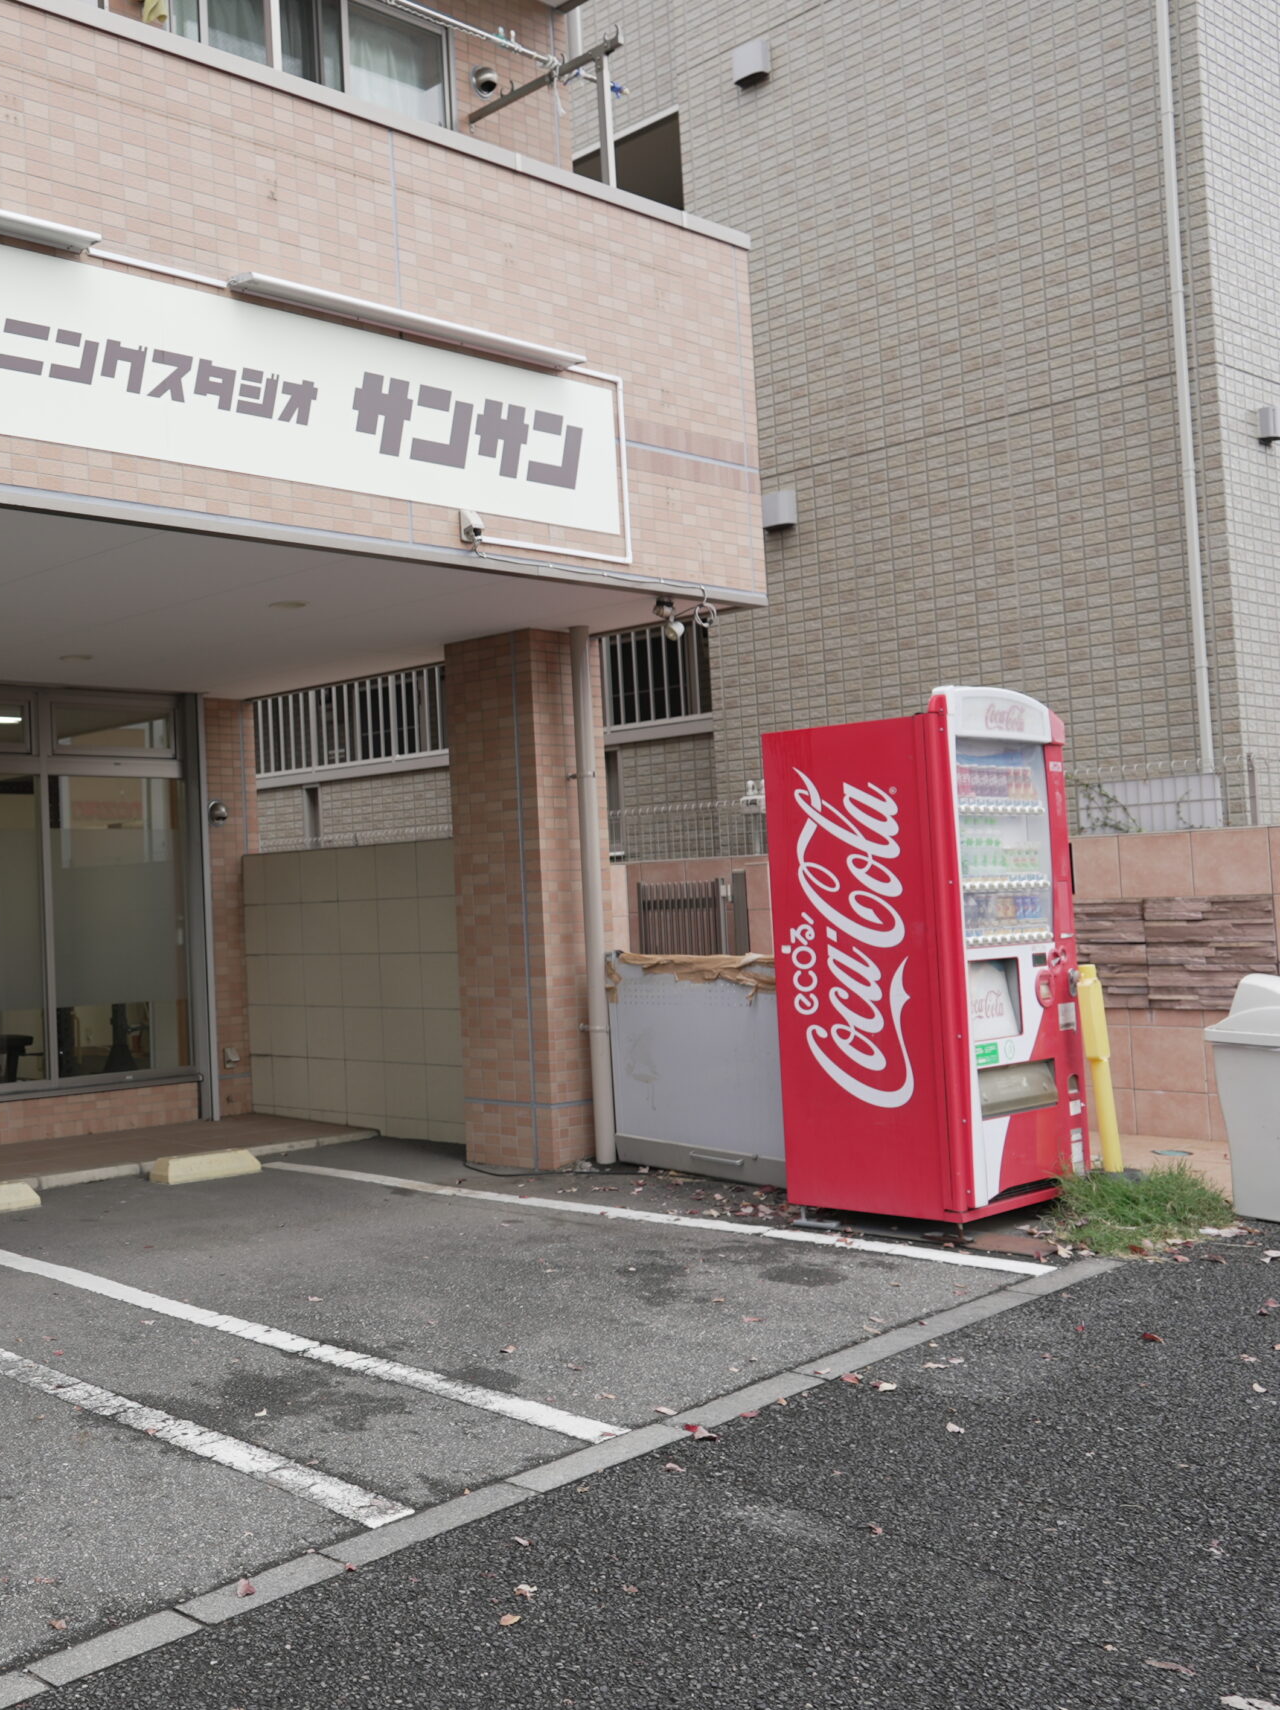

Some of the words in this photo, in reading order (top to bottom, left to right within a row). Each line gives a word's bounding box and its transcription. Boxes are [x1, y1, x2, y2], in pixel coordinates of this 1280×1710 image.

[352, 370, 584, 490] サンサン
[791, 766, 915, 1109] Coca-Cola
